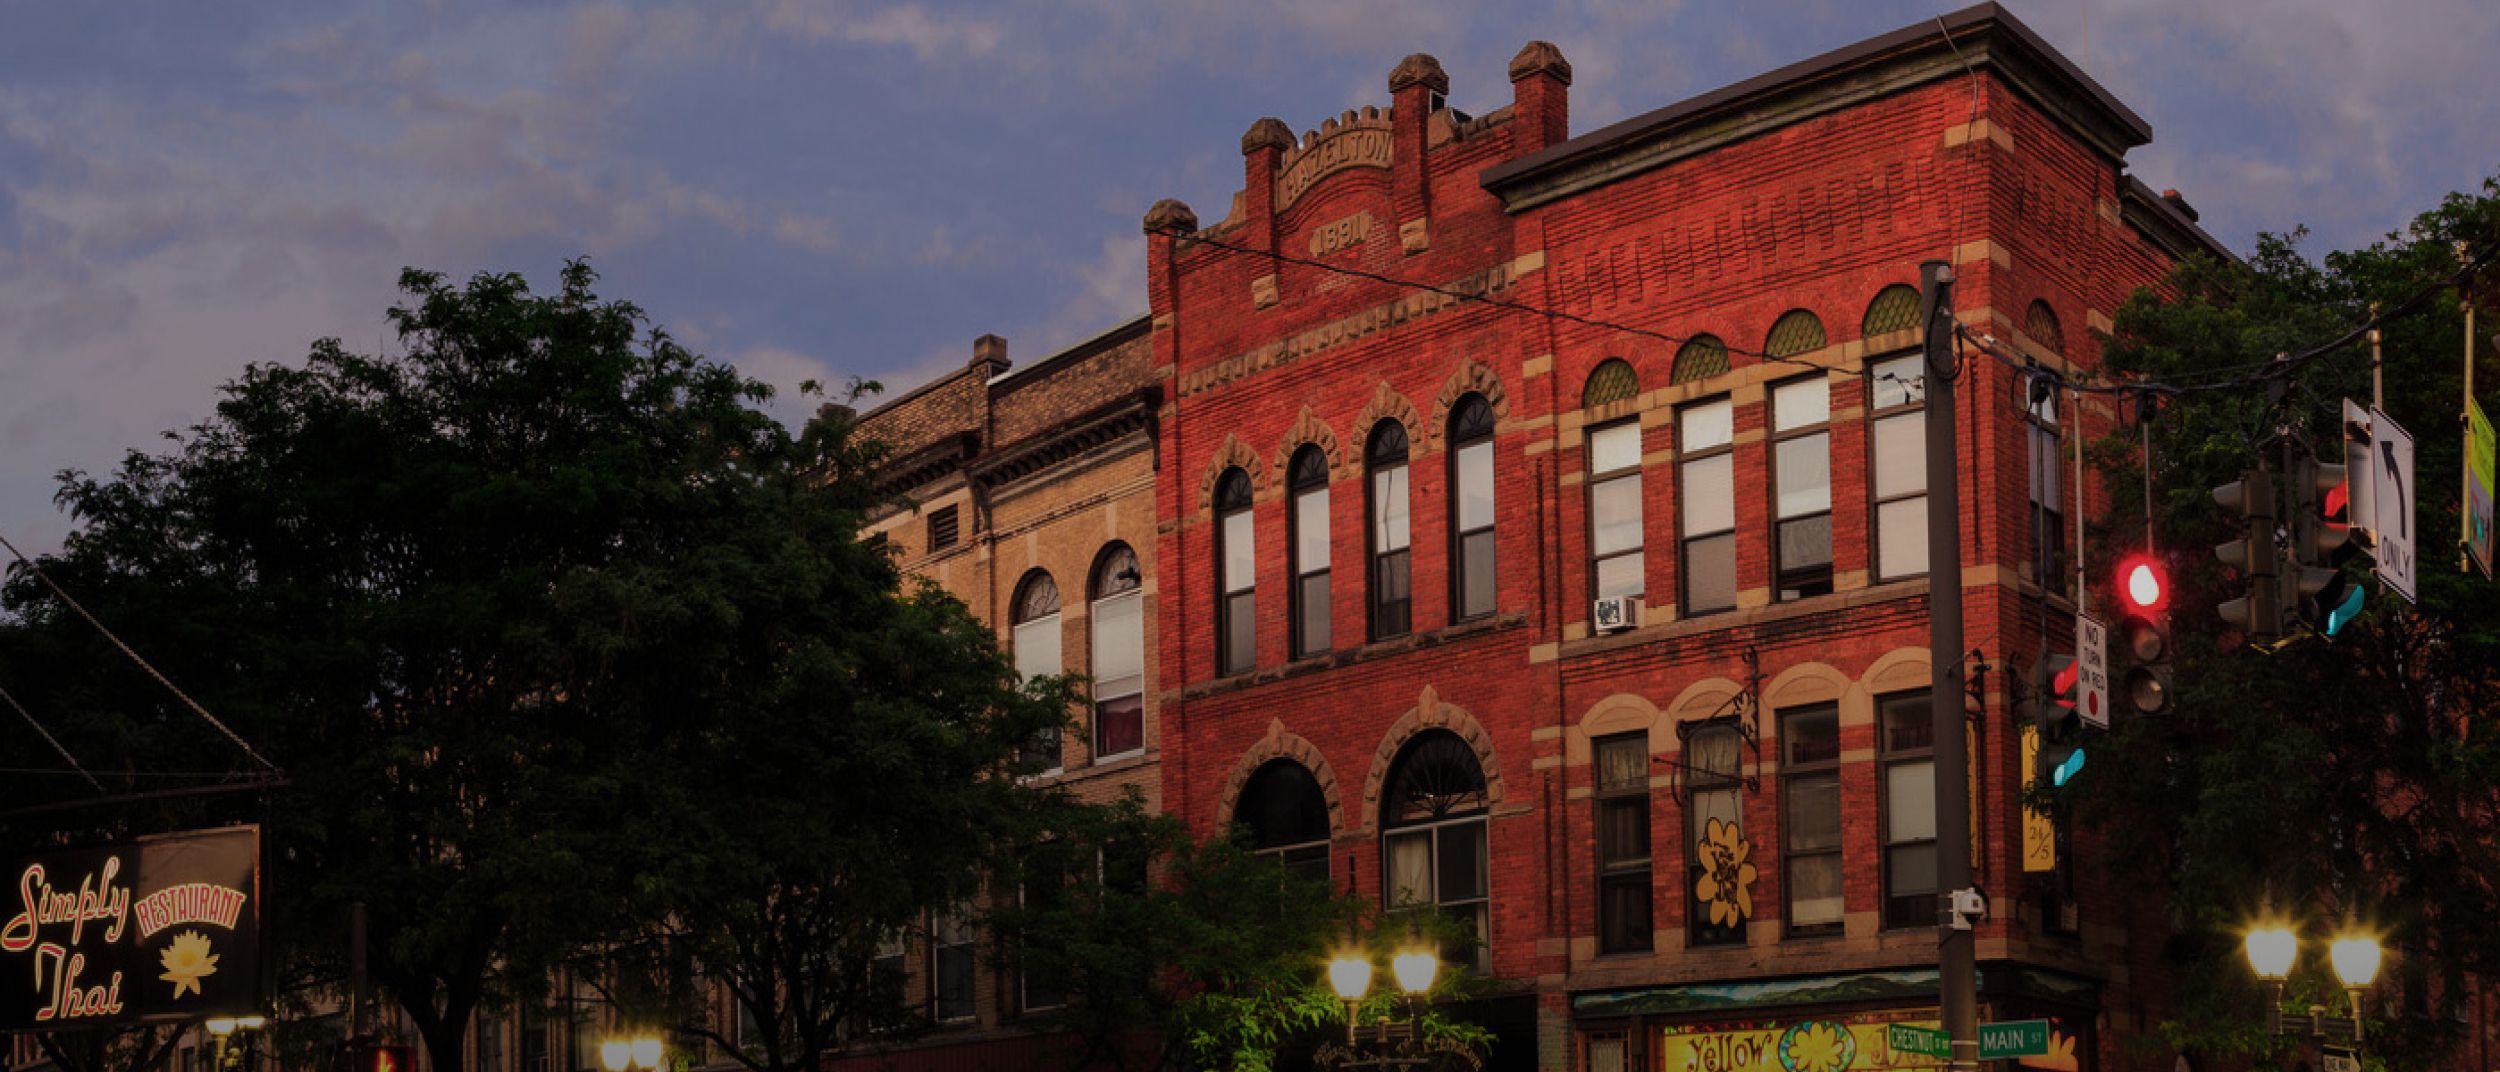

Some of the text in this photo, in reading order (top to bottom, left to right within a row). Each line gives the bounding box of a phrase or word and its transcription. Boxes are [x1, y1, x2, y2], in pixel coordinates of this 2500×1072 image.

[1315, 215, 1363, 253] 1891
[2382, 535, 2411, 583] ONLY
[2084, 622, 2099, 647] NO
[2084, 645, 2101, 668] TURN
[2081, 666, 2105, 690] ON RED
[1, 856, 130, 951] Simply
[134, 882, 247, 939] RESTAURANT
[35, 942, 124, 1021] Thai
[1891, 1025, 1934, 1053] CHESTNUT
[1983, 1030, 2042, 1051] MAIN ST
